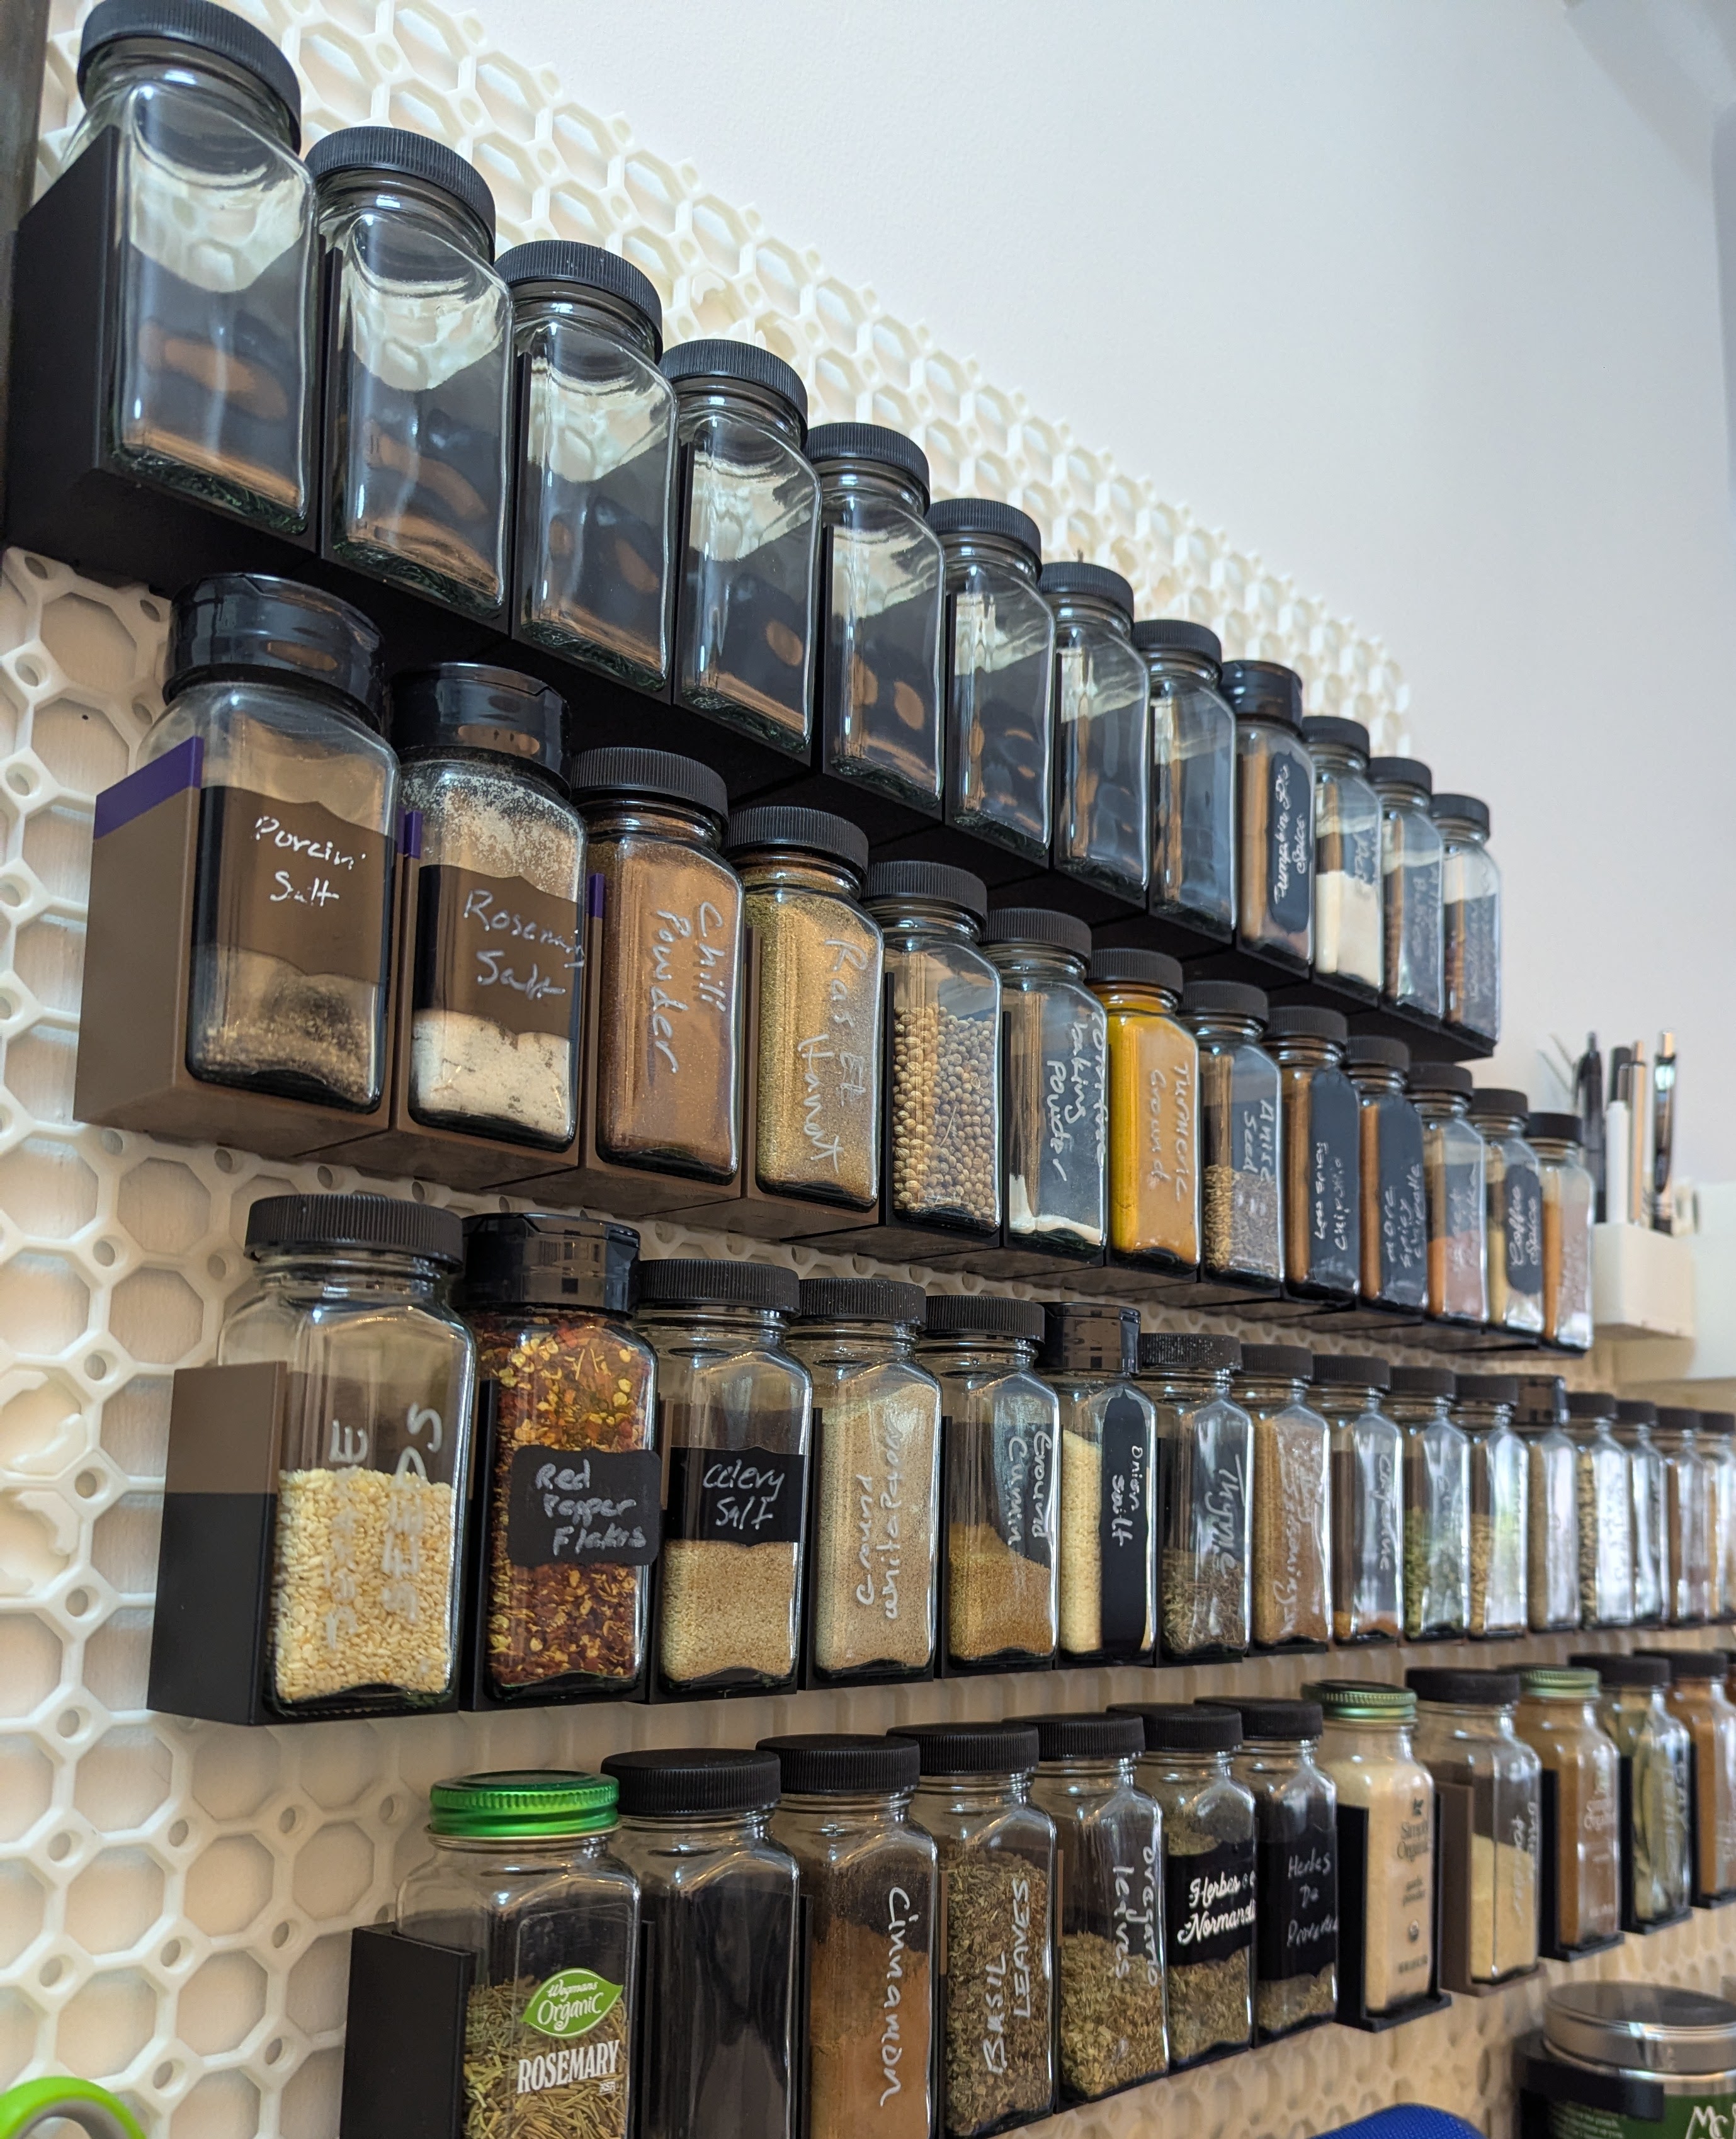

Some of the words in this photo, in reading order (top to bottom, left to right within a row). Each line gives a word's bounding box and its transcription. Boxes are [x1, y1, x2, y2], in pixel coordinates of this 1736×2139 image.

[253, 814, 366, 870] Porcini
[270, 871, 340, 907] Salt
[476, 950, 566, 999] Salt
[650, 909, 692, 1074] Powder
[824, 938, 869, 1029] Ras
[535, 1458, 591, 1490] Red
[1007, 1436, 1028, 1546] Cumin
[1032, 1430, 1053, 1538] Ground
[543, 1493, 637, 1528] Pepper
[1205, 1454, 1245, 1580] Thyme
[1189, 1870, 1241, 1909] Herbes
[1011, 1877, 1031, 2018] LEAVES
[537, 1991, 603, 2033] Organic
[547, 1978, 600, 1999] Wegmans
[880, 1887, 920, 2107] Cinnamon
[516, 2040, 620, 2094] ROSEMARY
